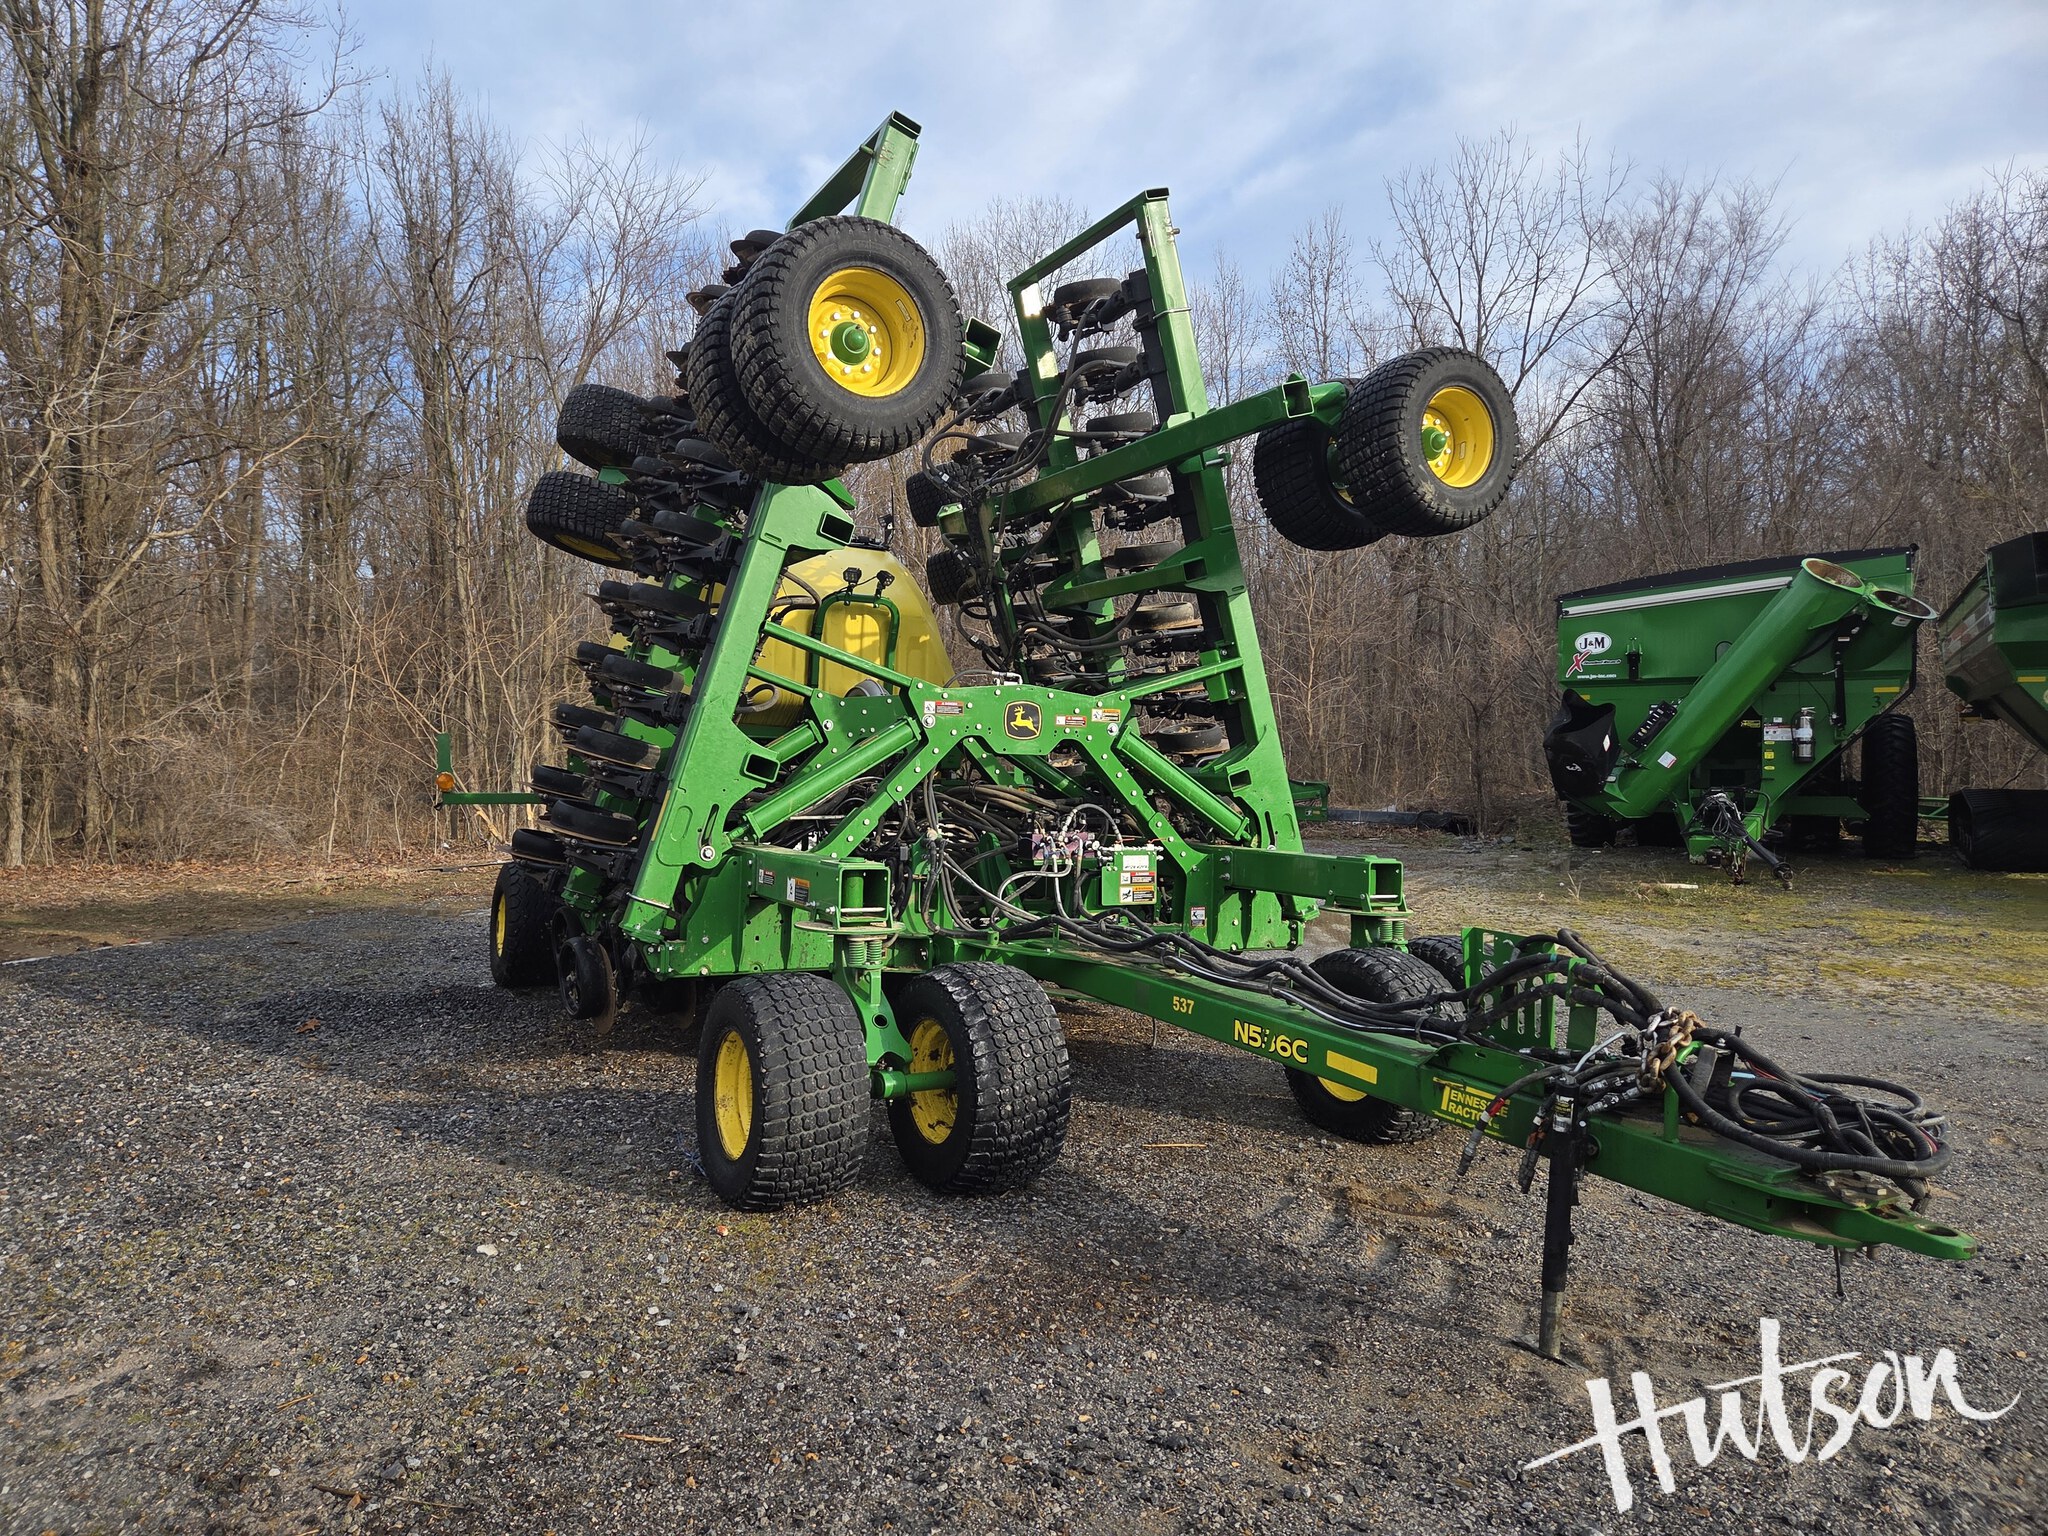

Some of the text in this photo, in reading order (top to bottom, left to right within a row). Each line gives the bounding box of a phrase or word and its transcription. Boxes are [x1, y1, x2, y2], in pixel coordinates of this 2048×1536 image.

[1579, 637, 1605, 650] J&M
[1871, 695, 1881, 708] 3
[1172, 996, 1195, 1015] 537
